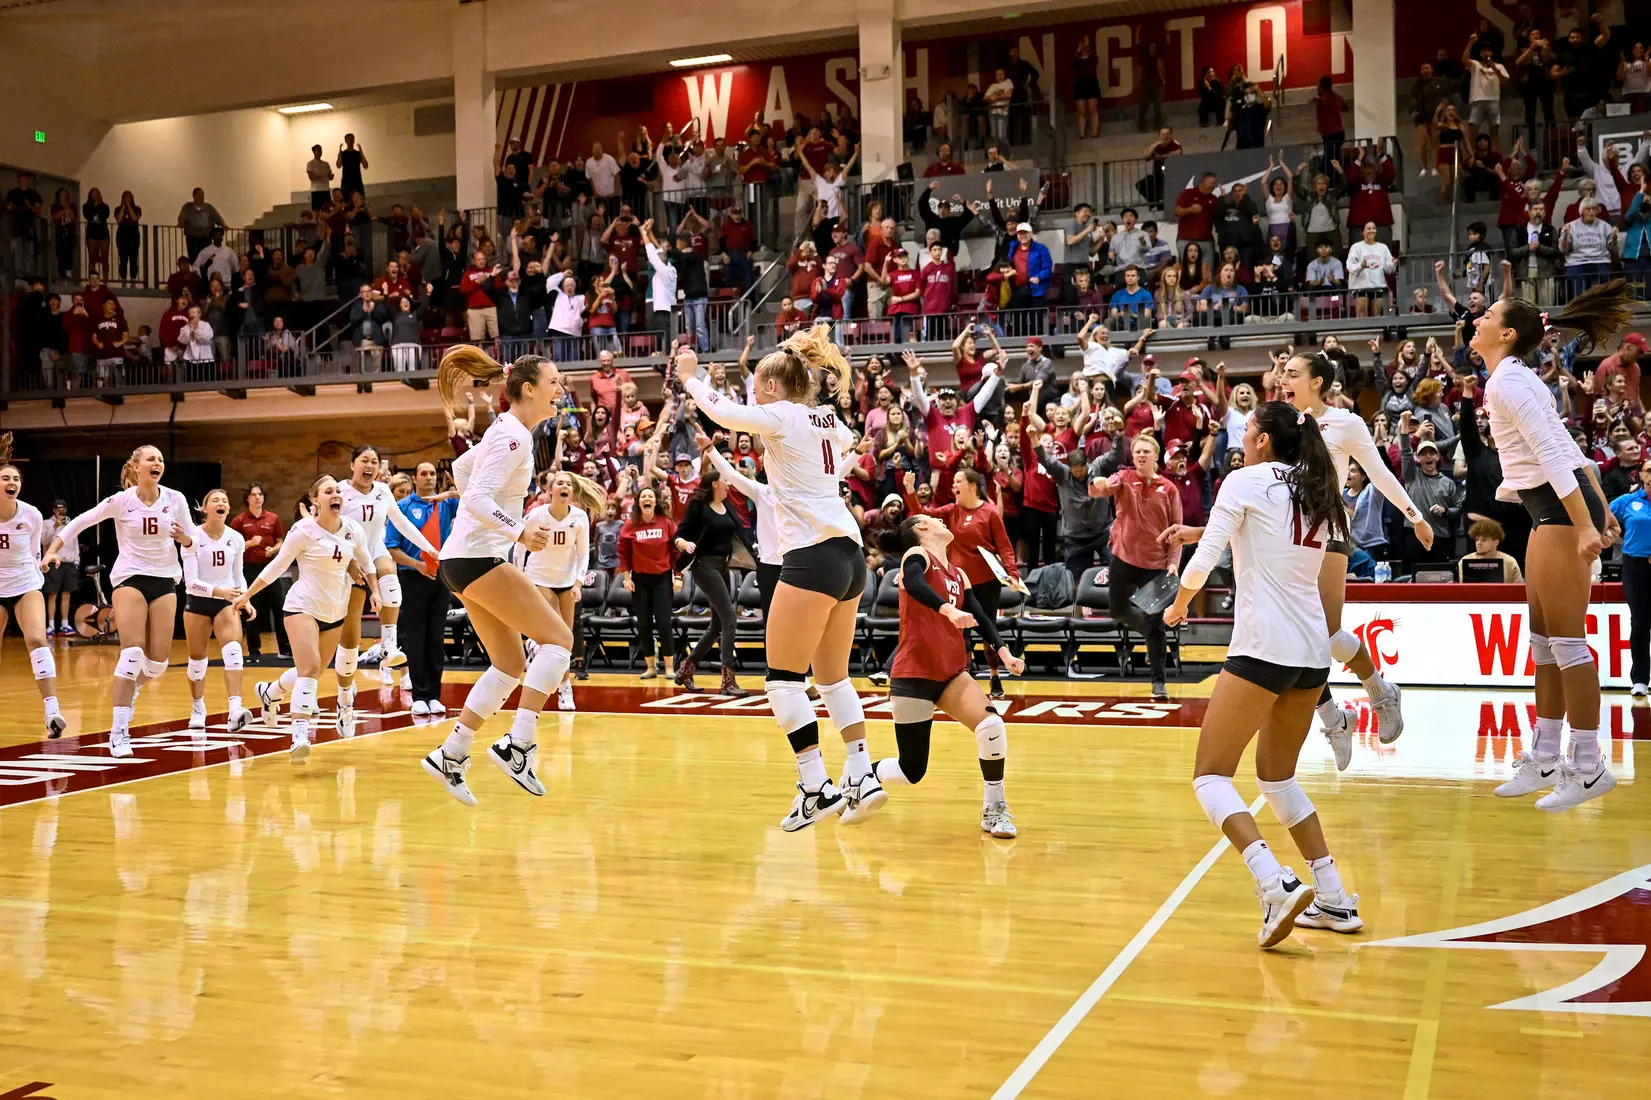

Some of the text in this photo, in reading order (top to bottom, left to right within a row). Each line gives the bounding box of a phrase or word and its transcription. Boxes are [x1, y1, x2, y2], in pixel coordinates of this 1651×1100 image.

[973, 197, 1004, 211] Creit
[1006, 196, 1034, 208] Unin
[821, 439, 835, 475] 11
[362, 504, 374, 522] 17
[142, 517, 158, 535] 16
[635, 528, 662, 541] WAZZU
[0, 533, 10, 549] 8
[554, 531, 566, 545] 10
[212, 550, 225, 567] 19
[332, 545, 342, 562] 4
